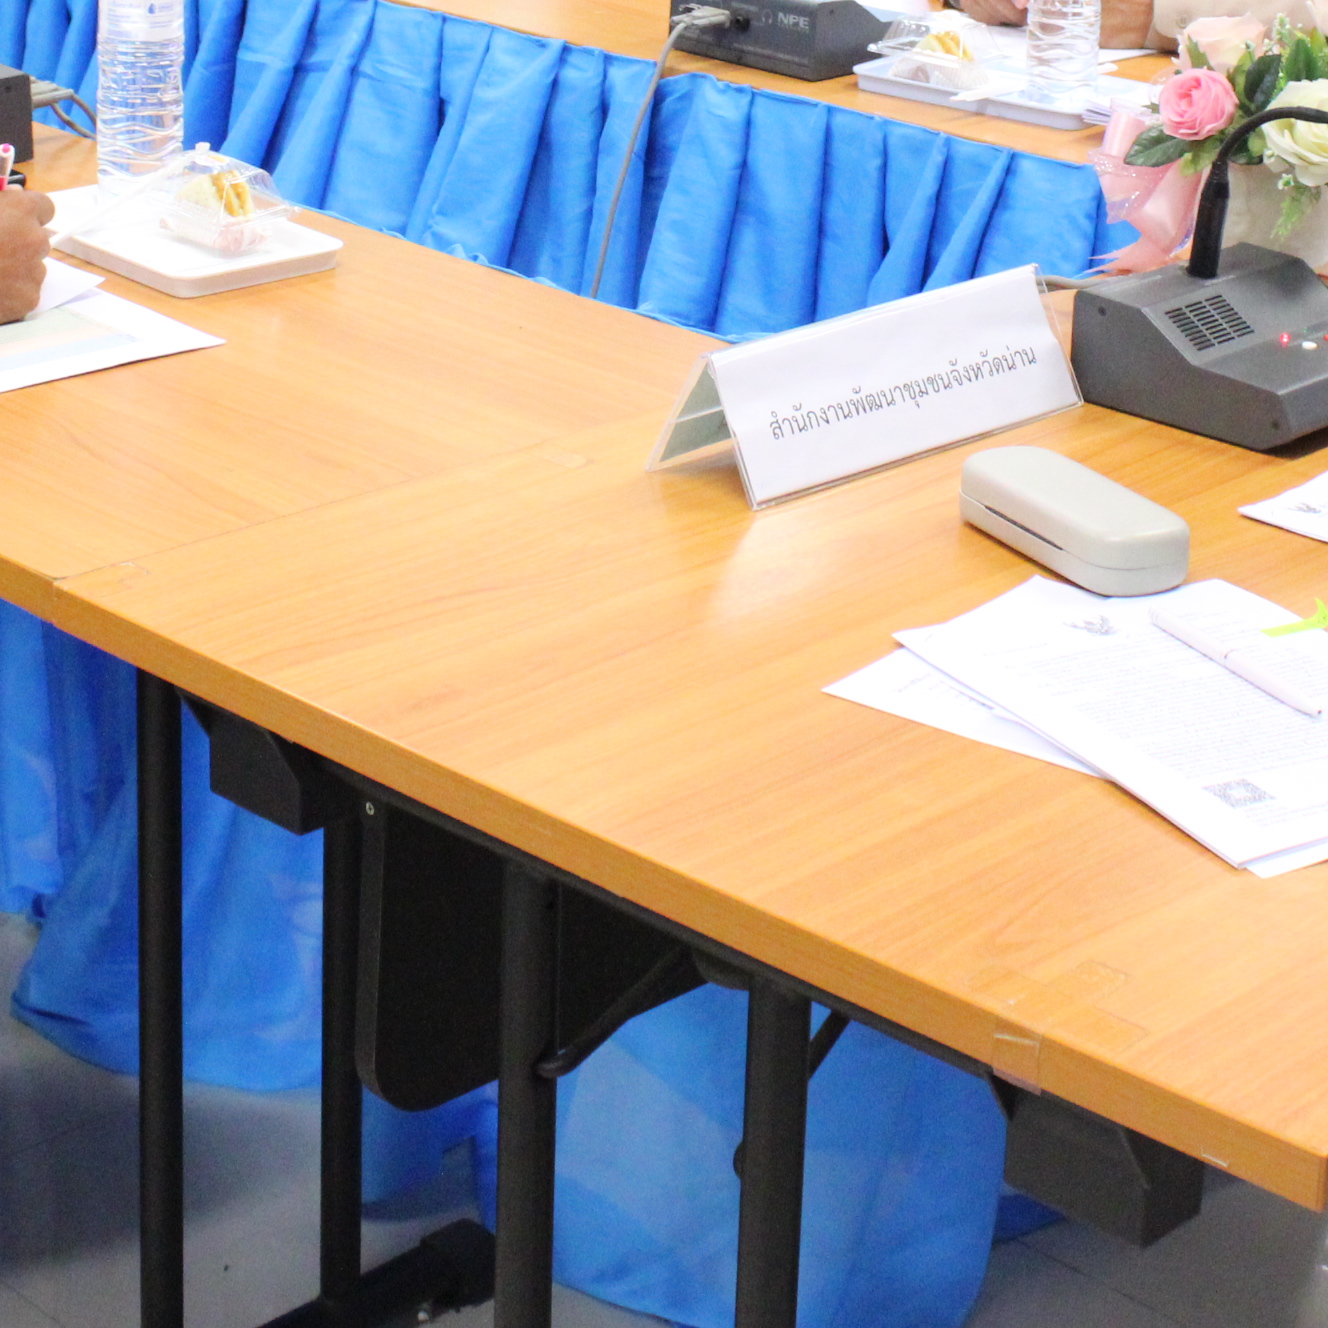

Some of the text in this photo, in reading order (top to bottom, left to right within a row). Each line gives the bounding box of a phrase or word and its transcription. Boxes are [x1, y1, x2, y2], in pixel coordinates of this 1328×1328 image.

[777, 11, 810, 30] NPE
[769, 345, 1038, 440] สำนักงานพัฒนาชุมชนจังหวัดน่าน
